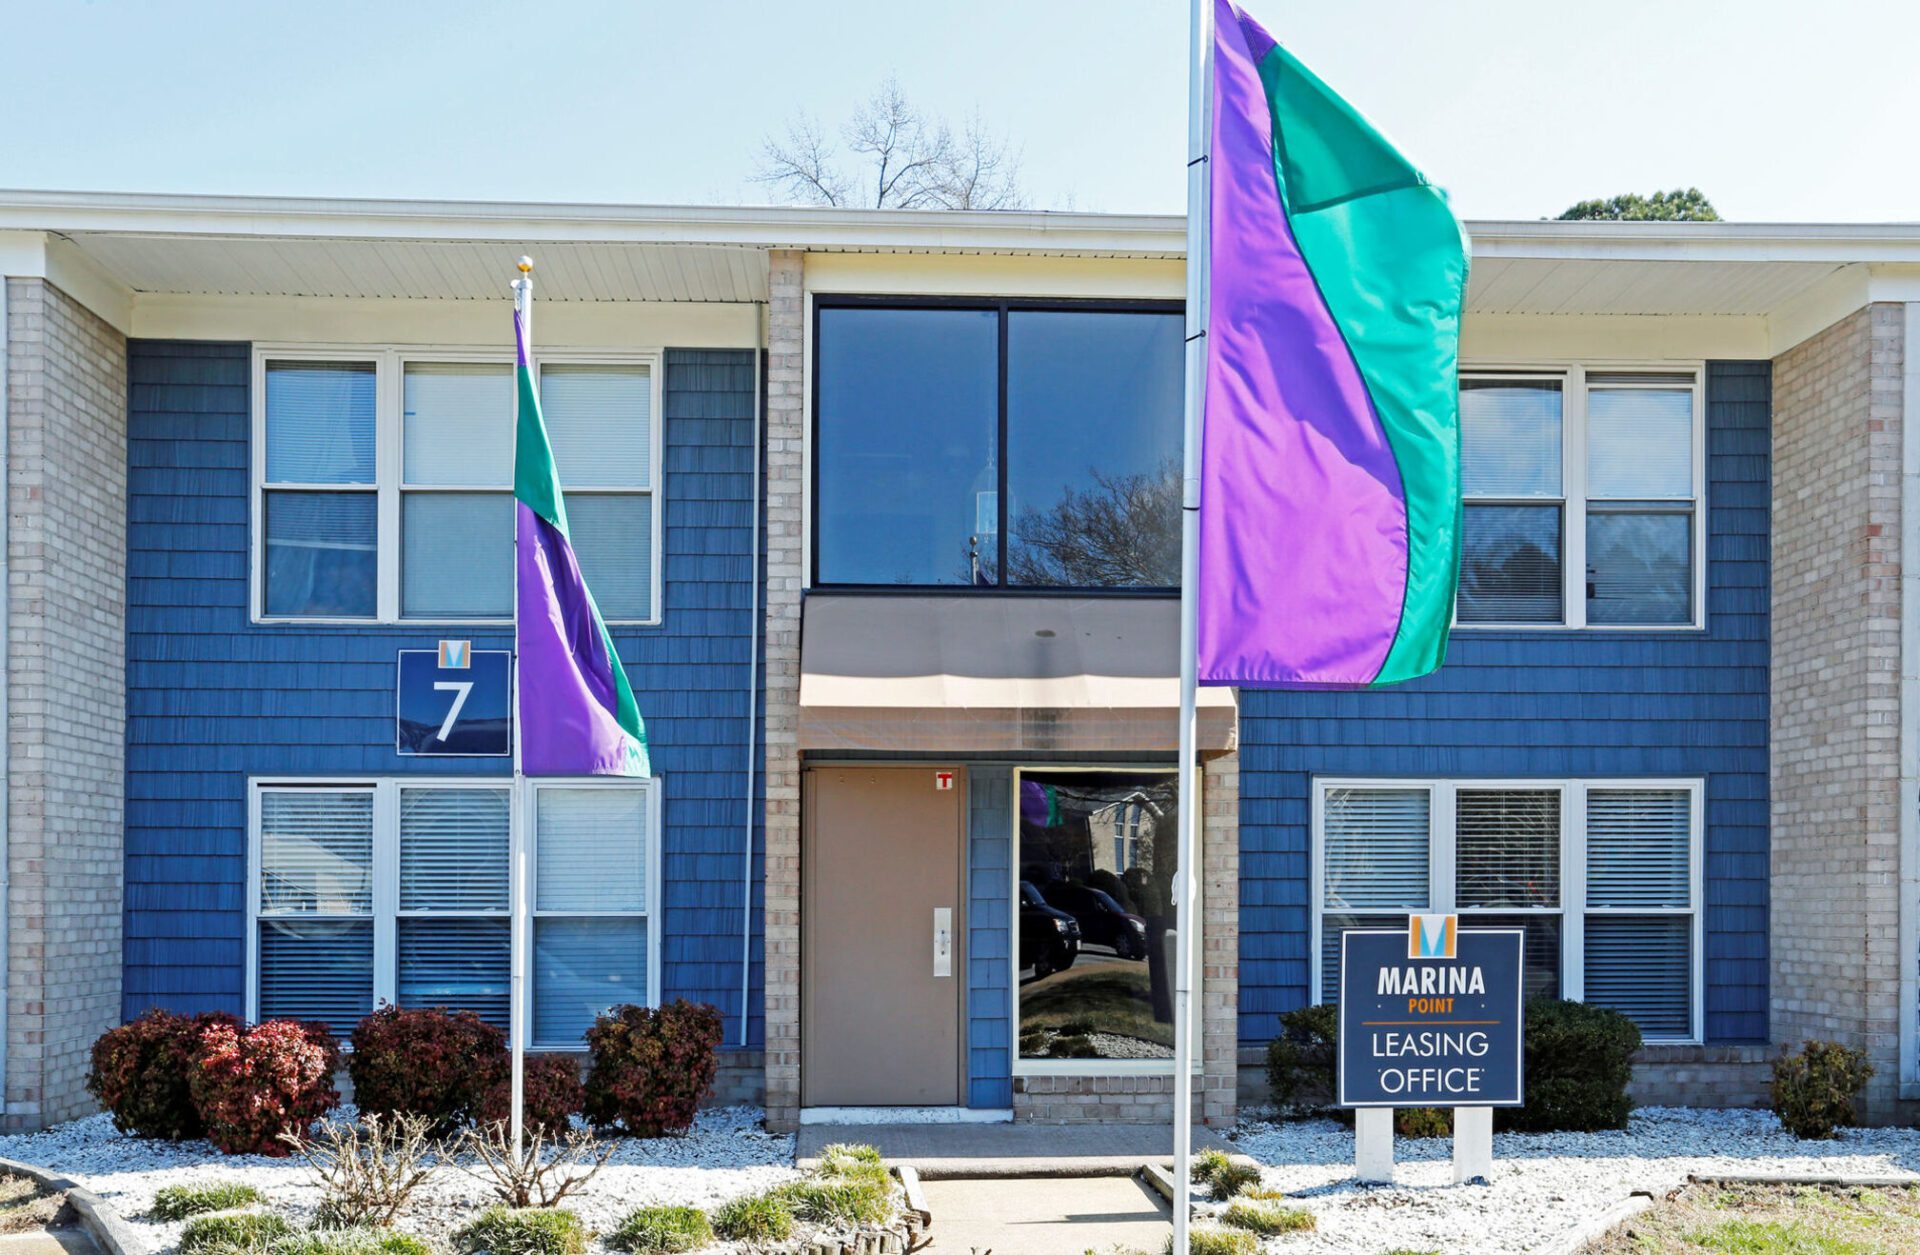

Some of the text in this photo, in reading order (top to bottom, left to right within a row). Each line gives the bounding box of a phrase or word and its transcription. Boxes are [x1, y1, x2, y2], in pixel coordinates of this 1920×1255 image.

[433, 681, 474, 742] 7
[937, 773, 952, 788] T
[1377, 966, 1485, 995] MARINA
[1408, 998, 1454, 1014] POINT
[1372, 1032, 1489, 1057] LEASING
[1380, 1068, 1481, 1093] OFFICE
